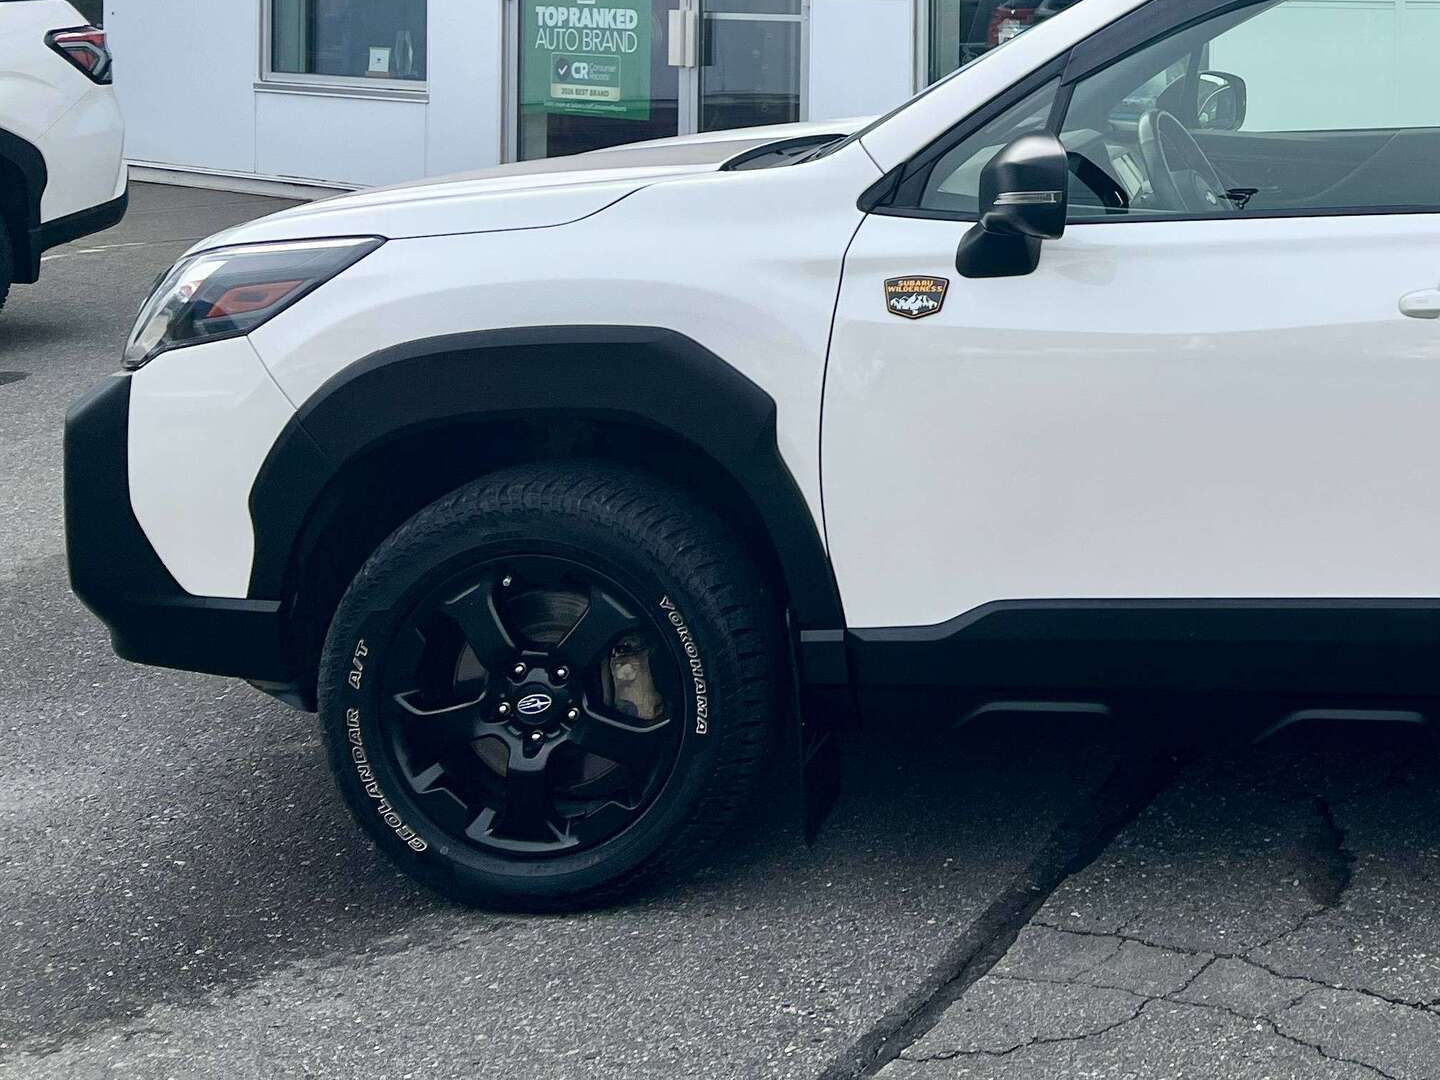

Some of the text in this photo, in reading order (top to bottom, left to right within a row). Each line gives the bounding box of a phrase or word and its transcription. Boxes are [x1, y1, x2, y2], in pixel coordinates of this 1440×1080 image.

[535, 28, 638, 53] AUTO BRAND
[571, 61, 588, 79] CR
[887, 285, 943, 293] WILDERNESS
[659, 595, 708, 735] YOKOHAMA
[346, 639, 428, 853] GEOLANDAR A/T
